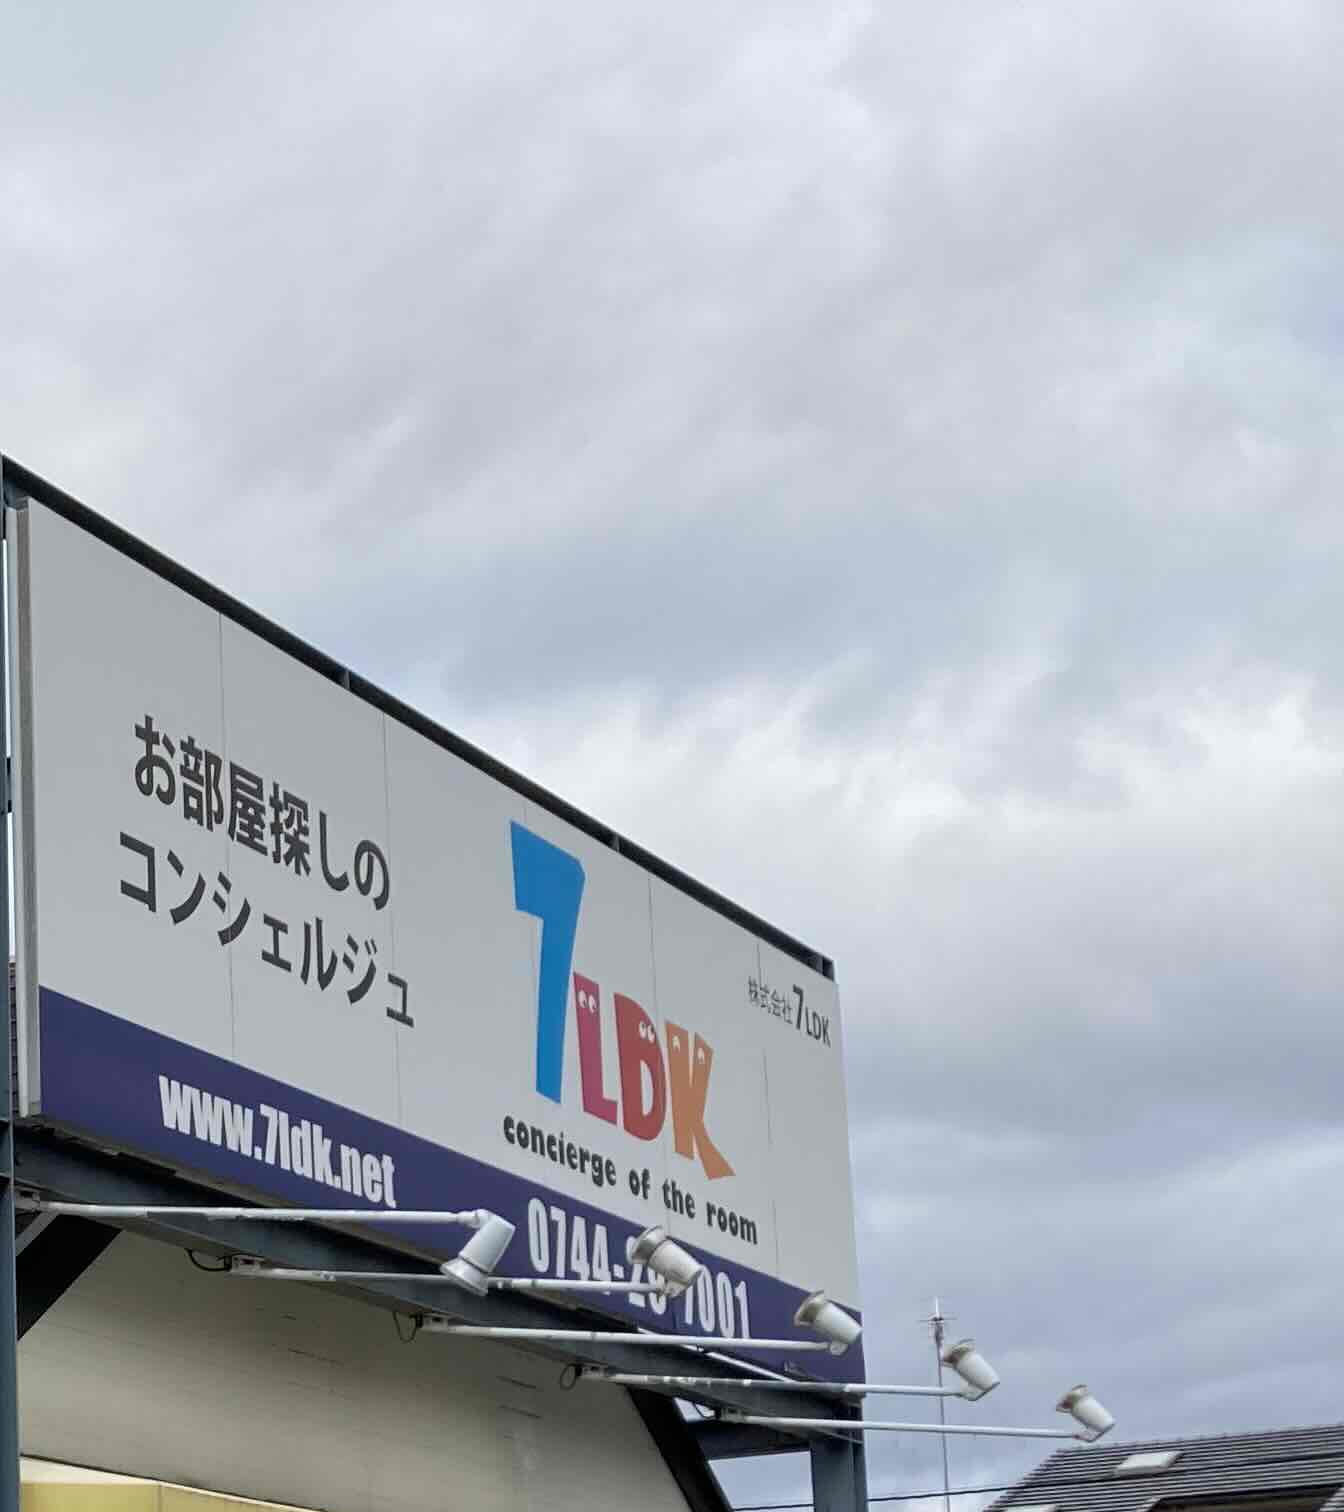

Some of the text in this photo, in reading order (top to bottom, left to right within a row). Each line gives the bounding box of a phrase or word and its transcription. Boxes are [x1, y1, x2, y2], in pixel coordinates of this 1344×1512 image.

[134, 713, 390, 912] お部屋探しの
[119, 830, 415, 1029] コンシェルジュ
[509, 819, 737, 1181] 7LDK
[158, 1074, 397, 1209] www.7ldk.net
[502, 1114, 759, 1246] concierge of the room
